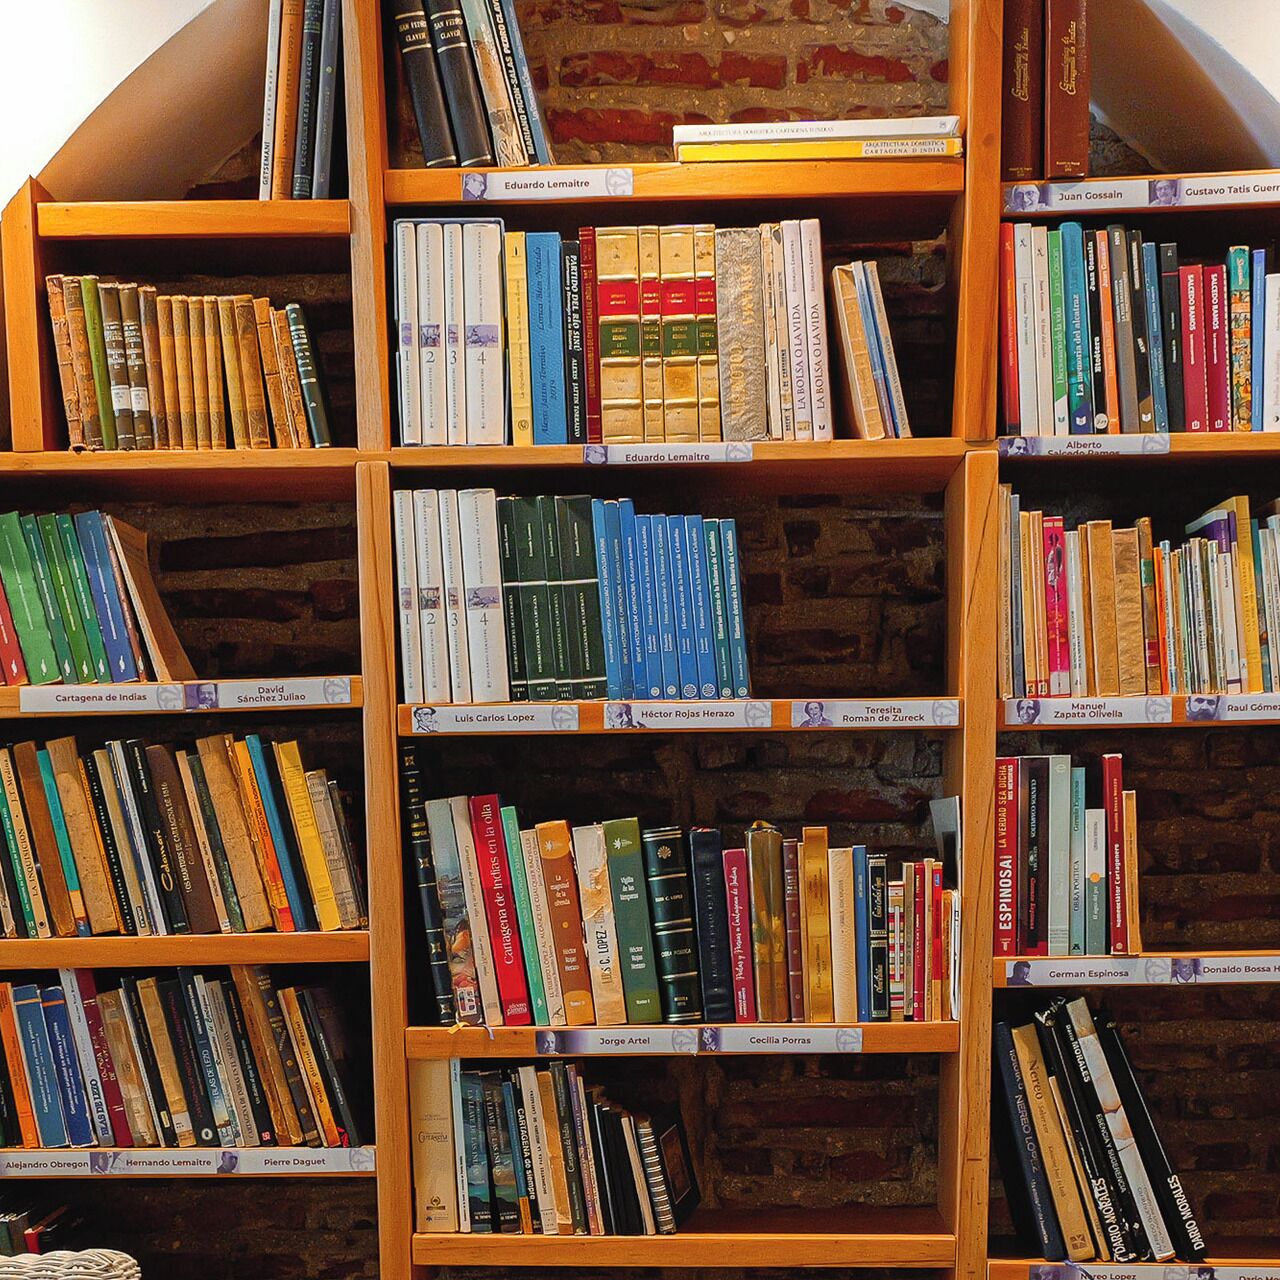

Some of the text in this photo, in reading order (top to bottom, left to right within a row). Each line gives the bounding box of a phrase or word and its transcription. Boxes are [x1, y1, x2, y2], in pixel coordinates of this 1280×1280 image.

[493, 0, 507, 23] CLAV
[505, 56, 525, 113] PICON-SALAS
[519, 115, 535, 155] MARIANO
[504, 179, 590, 191] Eduardo Lemaitre
[1059, 191, 1123, 202] Juan Gossain
[1185, 187, 1225, 197] Gustavo
[1227, 186, 1250, 195] Tatis
[570, 254, 579, 293] PARTIDO
[571, 294, 579, 312] DEL
[1188, 274, 1197, 331] SALCEDO RAMOS
[1211, 273, 1220, 330] SALCEDO RAMOS
[792, 303, 801, 333] VIDA
[1072, 294, 1084, 396] La memoria del alcatraz
[405, 351, 411, 362] 1
[426, 351, 436, 364] 2
[450, 350, 458, 365] 3
[477, 351, 487, 365] 4
[794, 349, 803, 360] O
[795, 362, 805, 395] BOLSA
[797, 396, 806, 410] LA
[1066, 441, 1102, 450] Alberto
[625, 452, 710, 463] Eduardo Lemaitre
[258, 685, 284, 695] David
[55, 692, 147, 704] Cartagena de Indias
[237, 692, 306, 703] Sánchez Juliao
[865, 705, 902, 715] Teresita
[1071, 701, 1106, 711] Manuel
[1227, 703, 1248, 713] Raul
[455, 713, 536, 724] Luis Carlos Lopez
[641, 708, 735, 720] Héctor Rojas Herazo
[842, 713, 925, 723] Roman de Zureck
[1054, 709, 1123, 721] Zapata Olivella
[998, 765, 1008, 788] DICHA
[998, 790, 1007, 805] SEA
[998, 807, 1007, 836] VERDAD
[998, 838, 1007, 848] LA
[482, 803, 517, 965] Cartagena de Indias en la olla
[595, 929, 610, 954] LOPEZ
[1049, 969, 1129, 980] German Espinosa
[1202, 964, 1242, 974] Donaldo
[1245, 964, 1272, 973] Bossa
[599, 1036, 650, 1048] Jorge Artel
[750, 1035, 811, 1045] Cecilia Porras
[1070, 1040, 1091, 1083] MORALES
[1029, 1059, 1044, 1100] Nereo
[1015, 1094, 1032, 1134] NEREO
[517, 1108, 535, 1200] CARTAGENA de siempre
[5, 1160, 89, 1172] Alejandro Obregon
[126, 1158, 212, 1167] Hernando Lemaitre
[264, 1157, 326, 1169] Pierre Daguet
[1095, 1177, 1117, 1224] MORALES
[1167, 1174, 1205, 1252] DARIO MORALES
